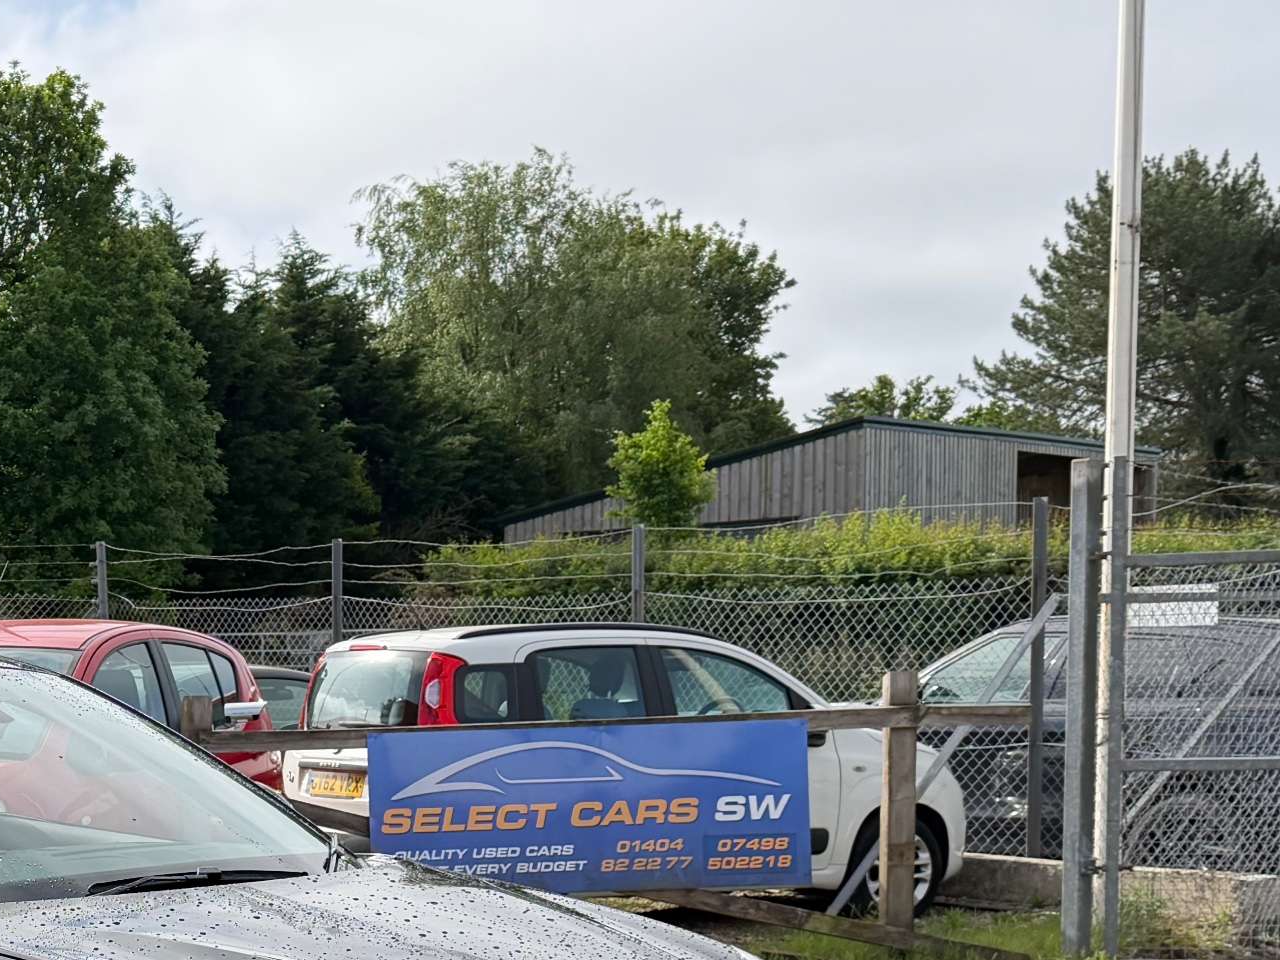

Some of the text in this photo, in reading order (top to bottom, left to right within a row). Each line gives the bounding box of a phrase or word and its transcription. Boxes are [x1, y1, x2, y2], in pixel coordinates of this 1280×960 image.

[381, 794, 792, 834] SELECT CARS SW
[472, 846, 521, 860] USED
[525, 844, 575, 858] CARS
[616, 838, 685, 854] 01404
[717, 837, 790, 852] 07498
[453, 862, 513, 877] EVERY
[516, 860, 588, 874] BUDGET
[707, 855, 793, 870] 502218
